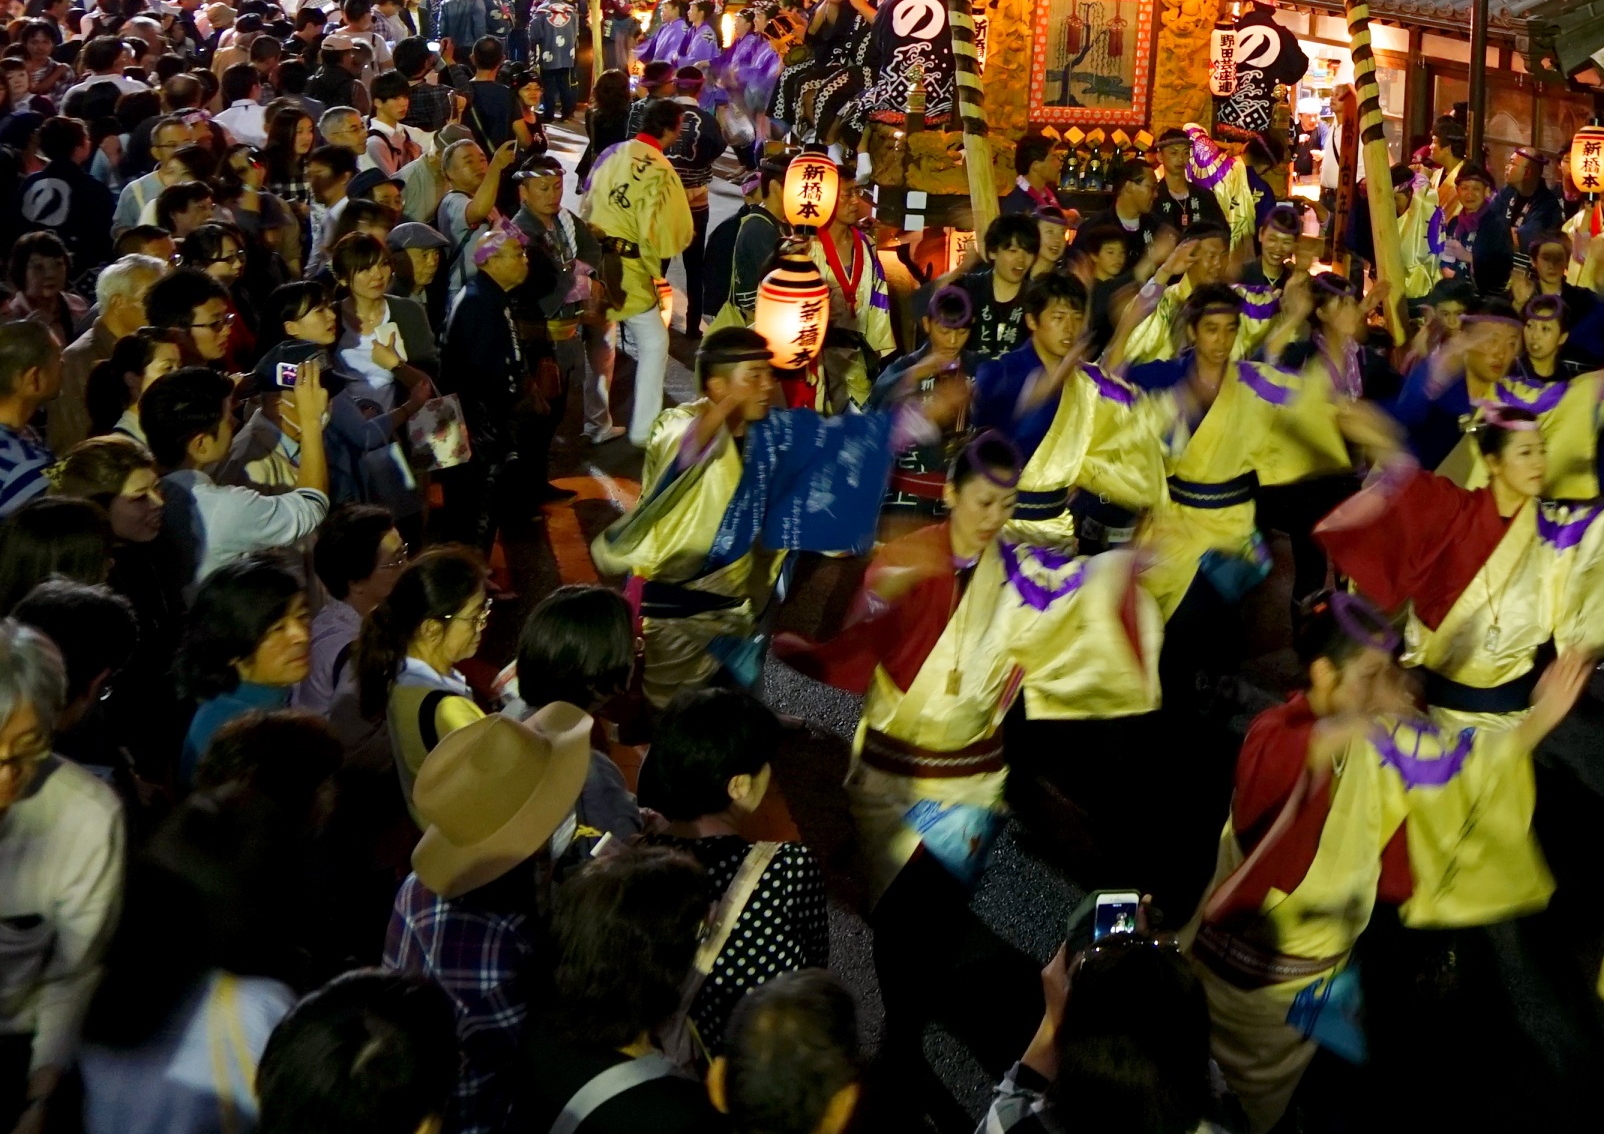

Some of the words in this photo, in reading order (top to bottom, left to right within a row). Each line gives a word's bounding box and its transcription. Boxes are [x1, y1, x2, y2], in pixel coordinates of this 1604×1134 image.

[1237, 24, 1281, 68] の
[1580, 140, 1602, 189] 新橋本
[797, 164, 826, 219] 新橋本
[787, 299, 823, 366] 新橋本
